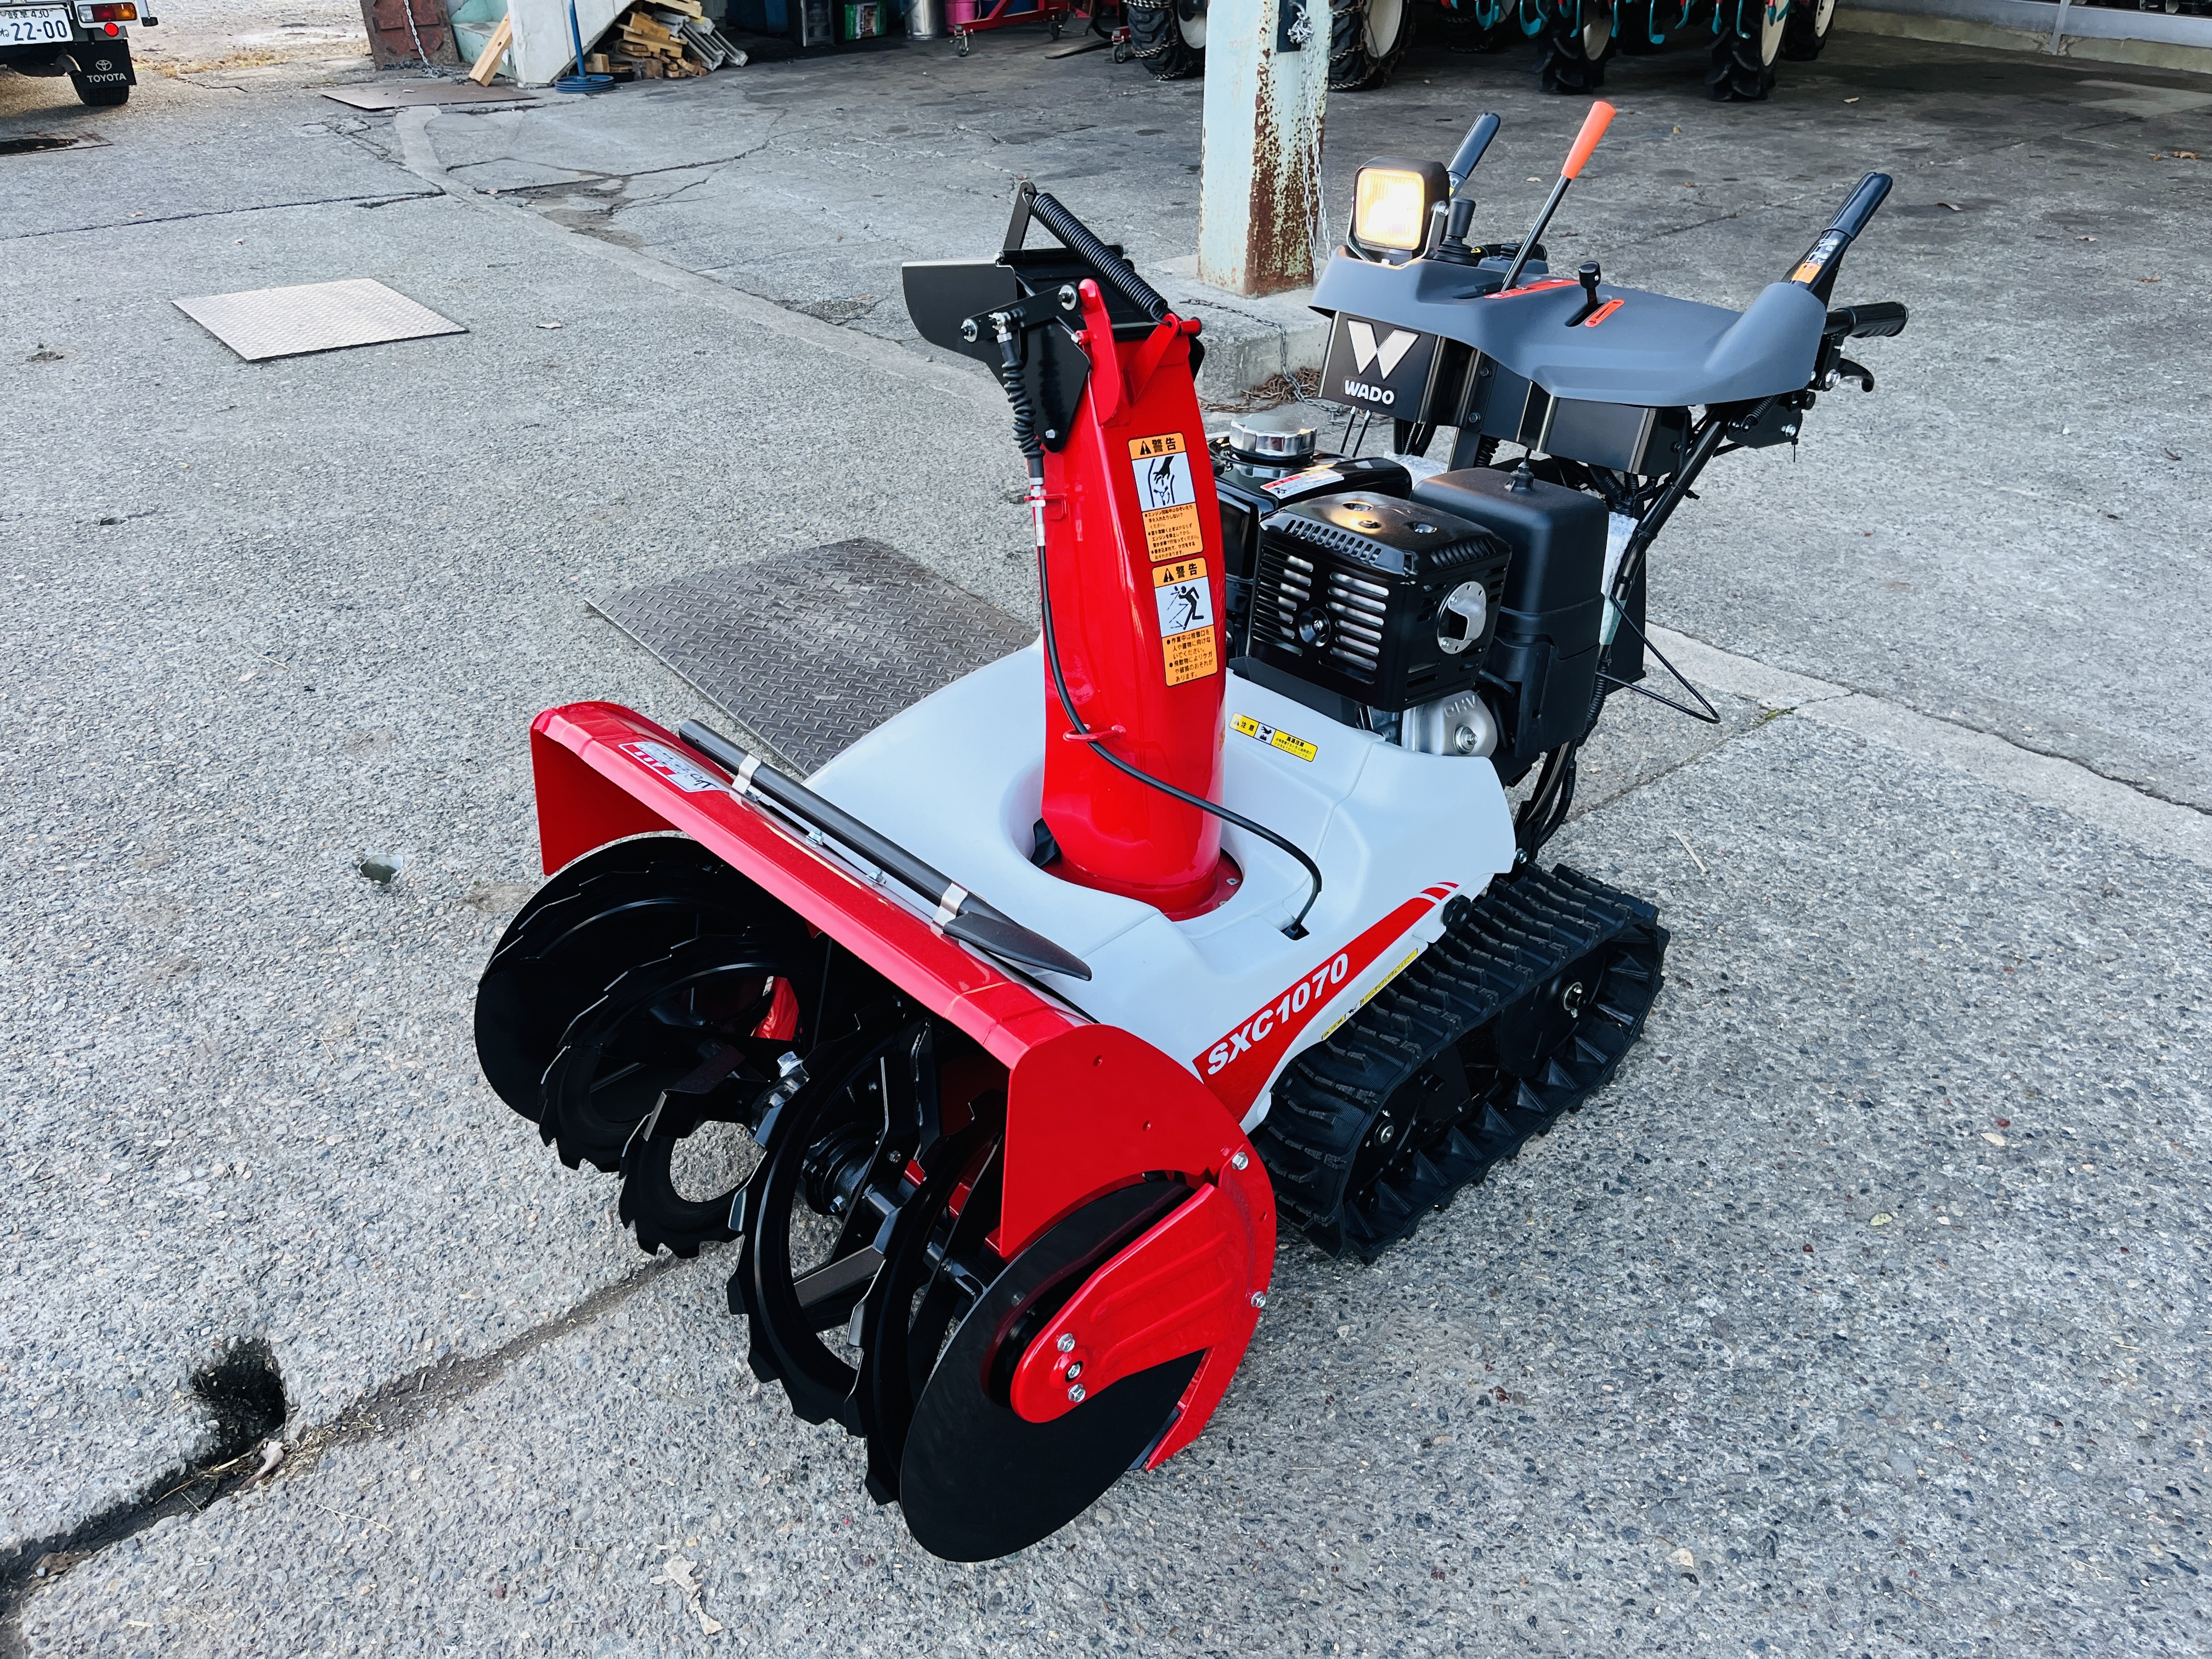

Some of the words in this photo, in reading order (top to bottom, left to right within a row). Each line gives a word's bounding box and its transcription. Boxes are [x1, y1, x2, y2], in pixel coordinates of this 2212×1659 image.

[31, 9, 49, 18] 430
[10, 20, 67, 41] 22-00
[87, 73, 127, 83] TOYOTA
[1345, 380, 1395, 405] WADO
[1152, 437, 1176, 453] 警告
[1176, 563, 1198, 579] 警告
[1240, 721, 1255, 732] 注意
[1207, 953, 1348, 1075] SXC1070
